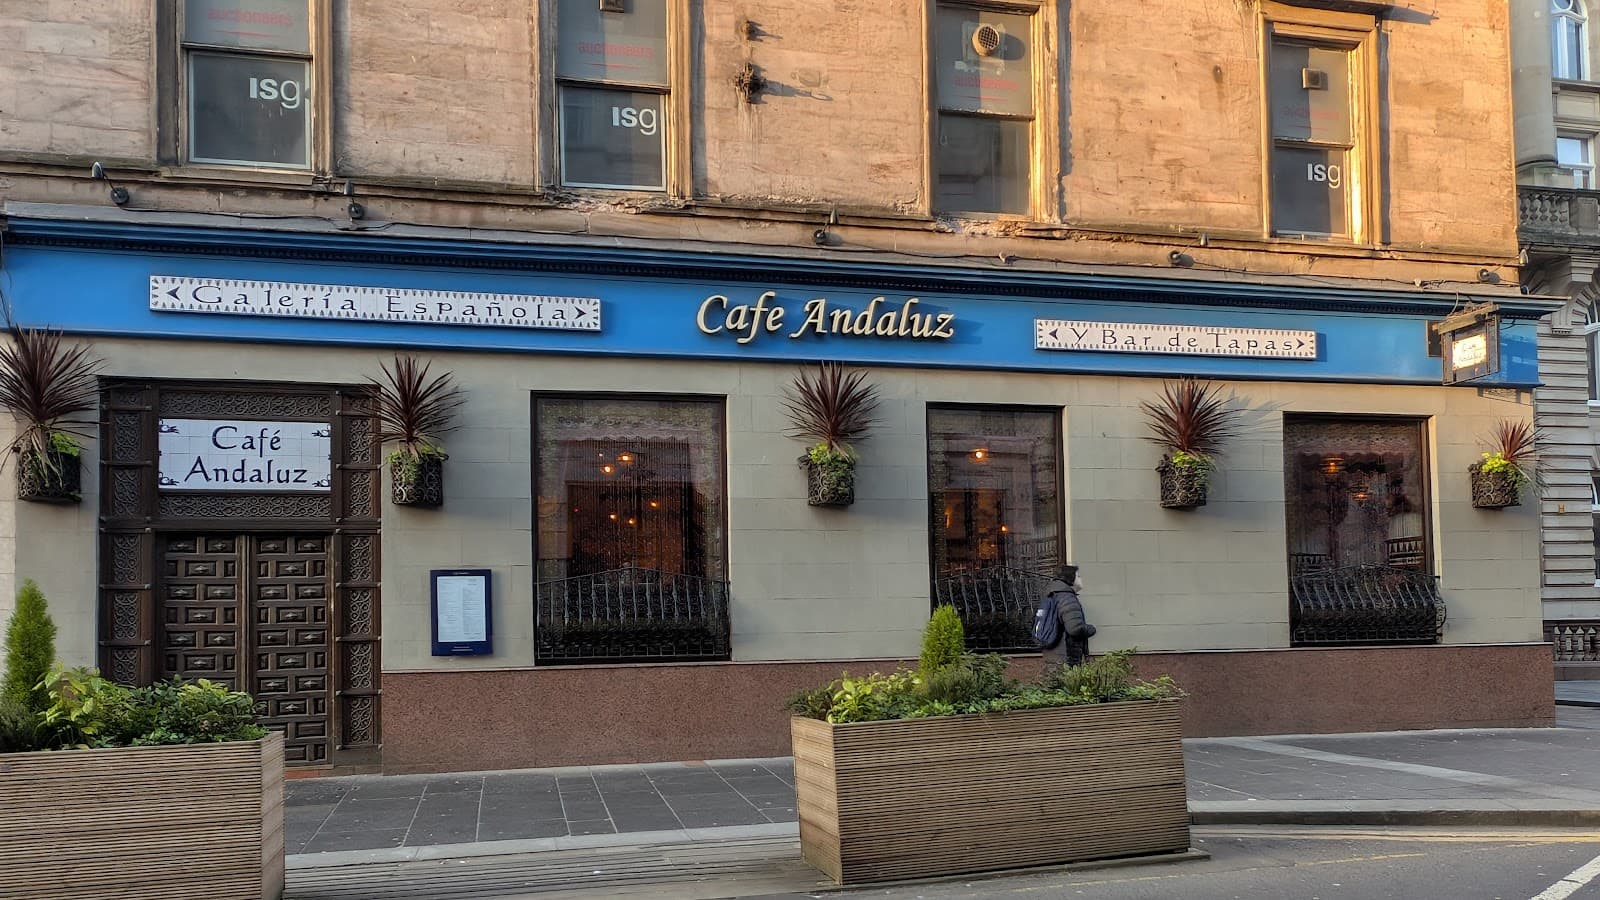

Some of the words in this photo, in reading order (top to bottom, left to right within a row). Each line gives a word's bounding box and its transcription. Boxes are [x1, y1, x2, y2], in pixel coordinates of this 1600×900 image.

[191, 285, 357, 311] Galería
[384, 295, 567, 320] Española
[696, 291, 785, 344] Cafe
[789, 296, 955, 339] Andaluz
[1101, 328, 1151, 346] Bar
[1168, 332, 1198, 349] de
[1207, 332, 1293, 351] Tapas
[211, 425, 282, 458] Café
[184, 455, 308, 484] Andaluz
